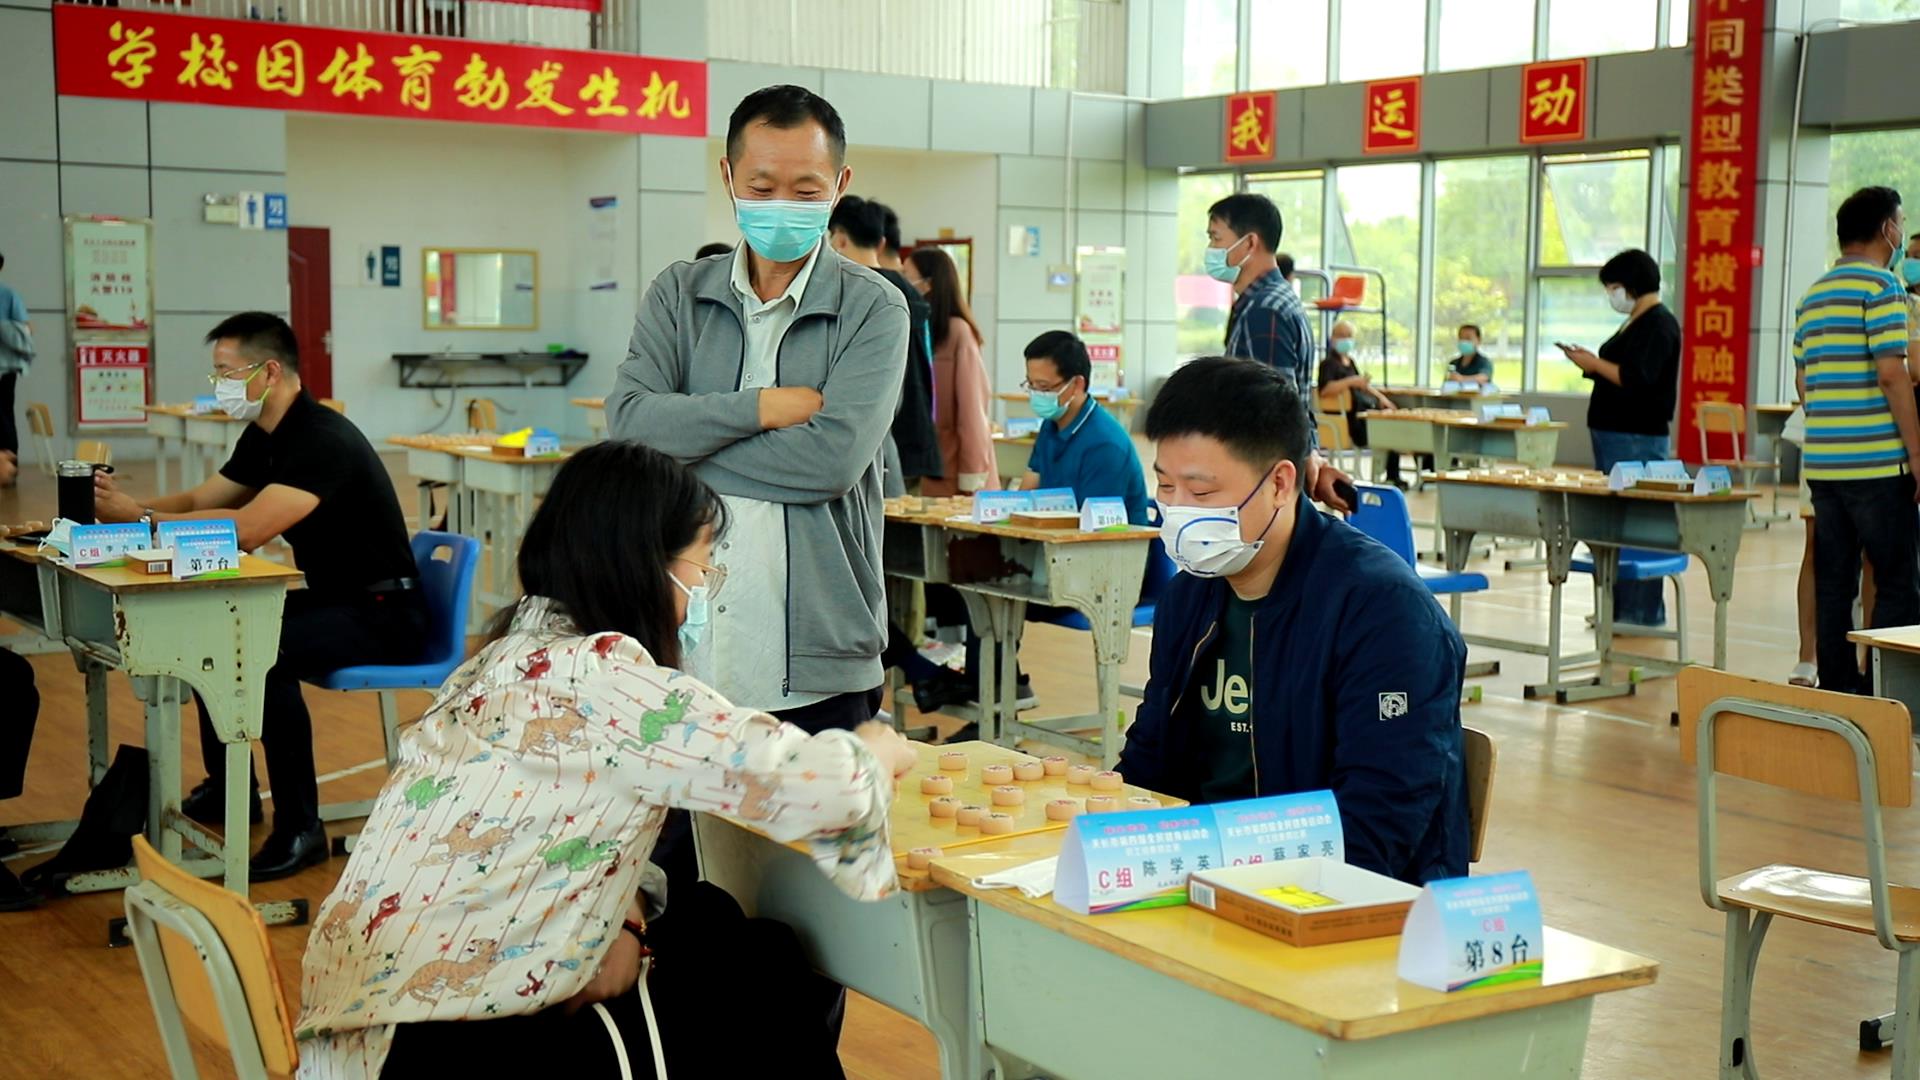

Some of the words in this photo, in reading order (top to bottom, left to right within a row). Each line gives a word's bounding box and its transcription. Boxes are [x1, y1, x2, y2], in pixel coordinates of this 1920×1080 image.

[107, 20, 691, 120] 学校因体育勃发生机
[1231, 96, 1271, 154] 我
[1371, 89, 1414, 140] 运
[1529, 73, 1577, 126] 动
[101, 350, 140, 363] 灭火器
[79, 547, 100, 558] C组
[190, 557, 229, 571] 第7台
[1098, 866, 1134, 889] C组
[1142, 854, 1210, 878] 陈学英
[1482, 917, 1505, 933] C组
[1465, 933, 1529, 973] 第8台
